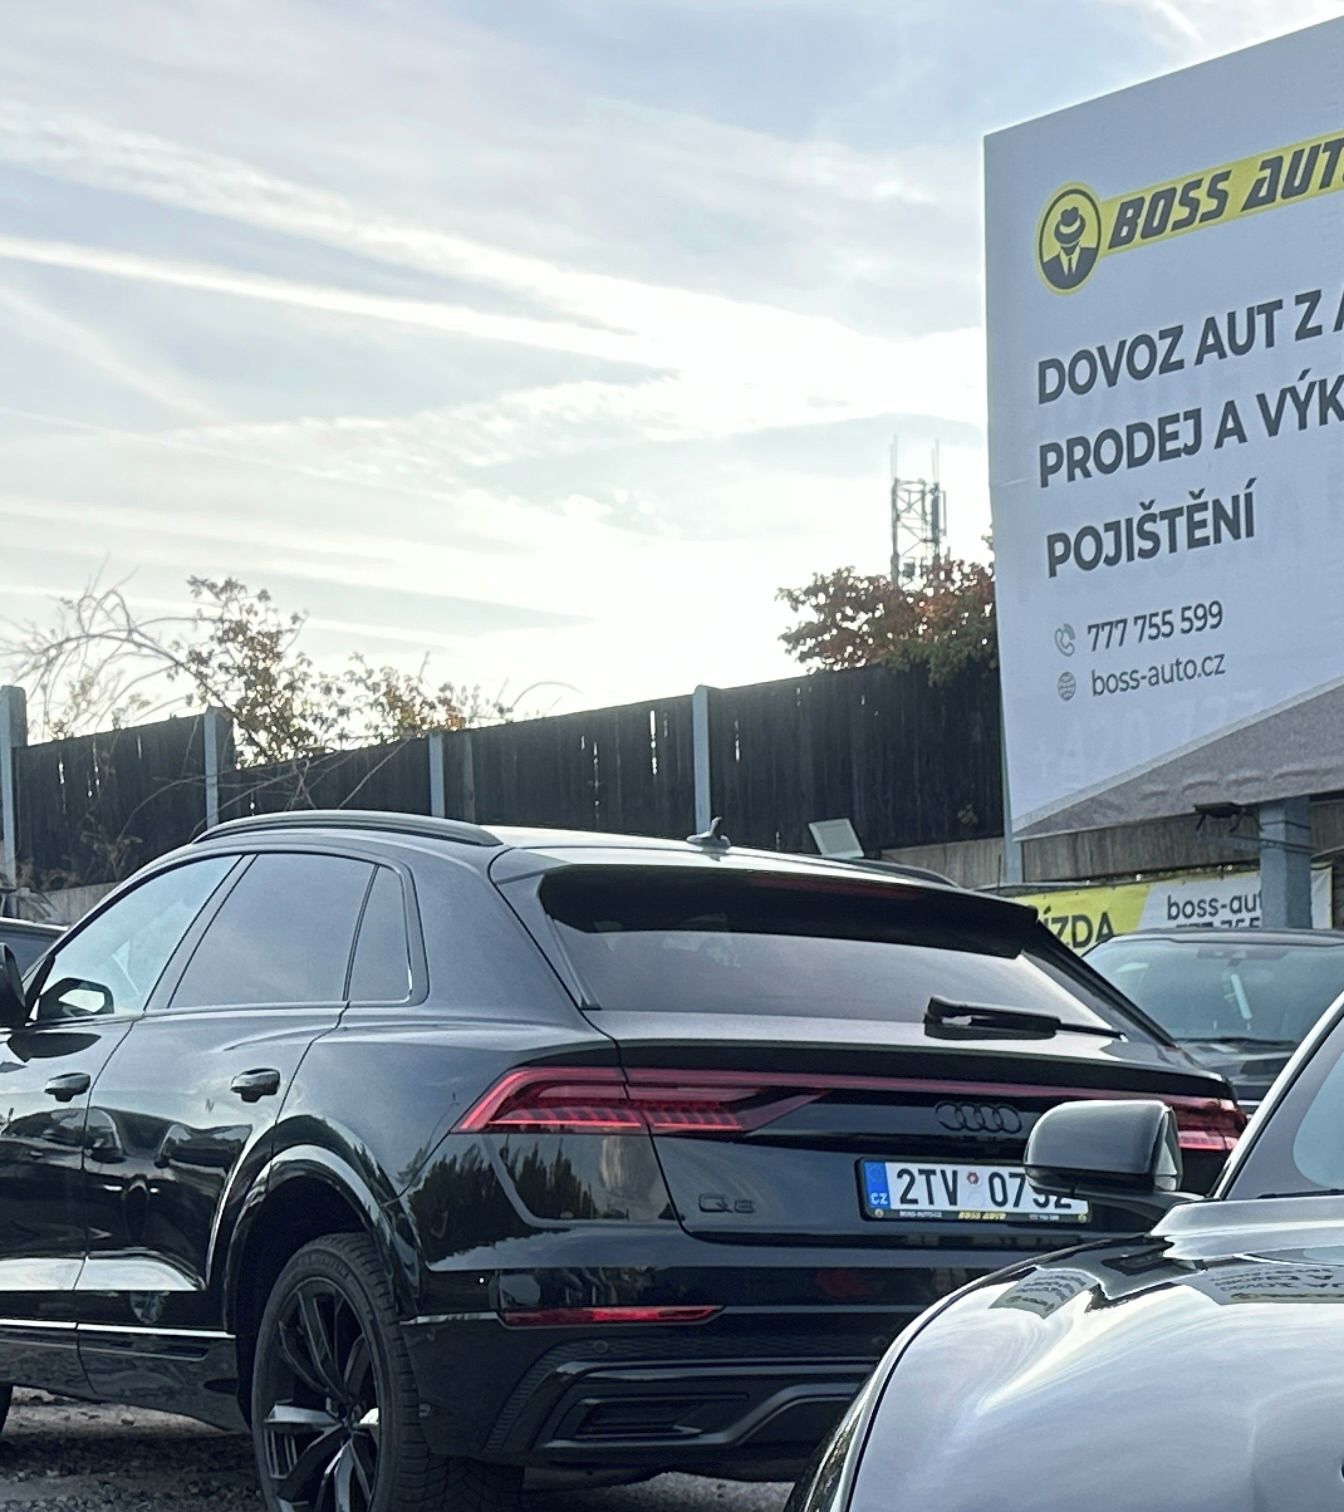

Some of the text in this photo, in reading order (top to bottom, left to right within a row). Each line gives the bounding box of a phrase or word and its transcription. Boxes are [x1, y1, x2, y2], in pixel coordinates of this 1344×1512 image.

[1107, 169, 1232, 250] BOSS
[1037, 324, 1185, 404] DOVOZ
[1194, 299, 1284, 365] AUT
[1294, 290, 1322, 341] Z
[1039, 407, 1202, 488] PRODEJ
[1214, 400, 1247, 449] A
[1046, 477, 1257, 578] POJIŠTĚNÍ
[1087, 600, 1223, 652] 777 755 599
[1091, 652, 1226, 697] boss-auto.cz
[870, 1193, 888, 1205] CZ
[896, 1168, 958, 1206] 2TV
